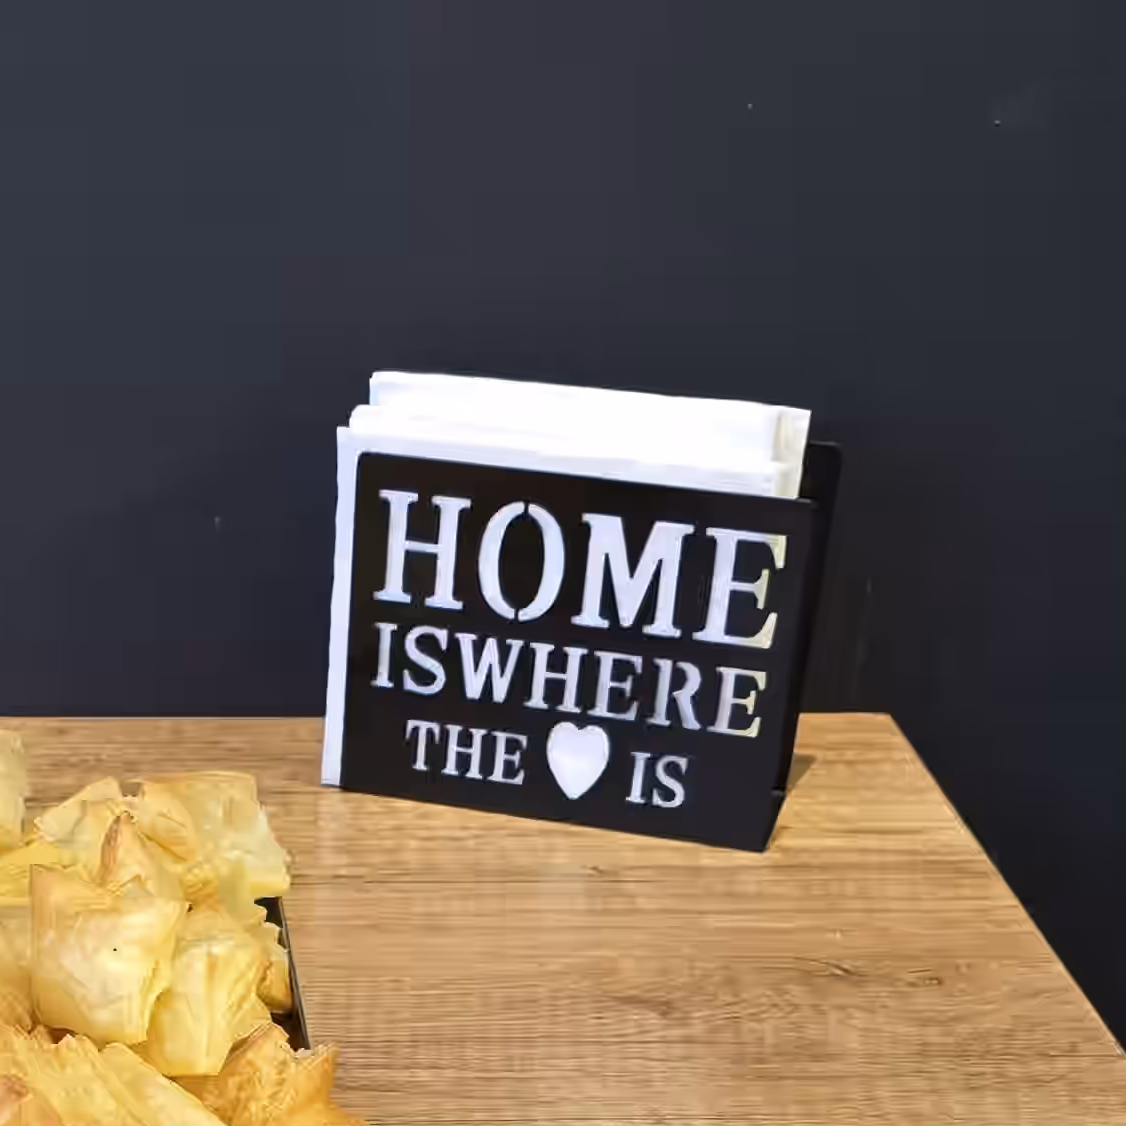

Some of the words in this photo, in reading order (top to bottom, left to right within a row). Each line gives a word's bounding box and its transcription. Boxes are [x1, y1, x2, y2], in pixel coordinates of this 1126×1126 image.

[374, 489, 787, 650] HOME
[405, 719, 528, 785] THE
[626, 751, 689, 808] IS
